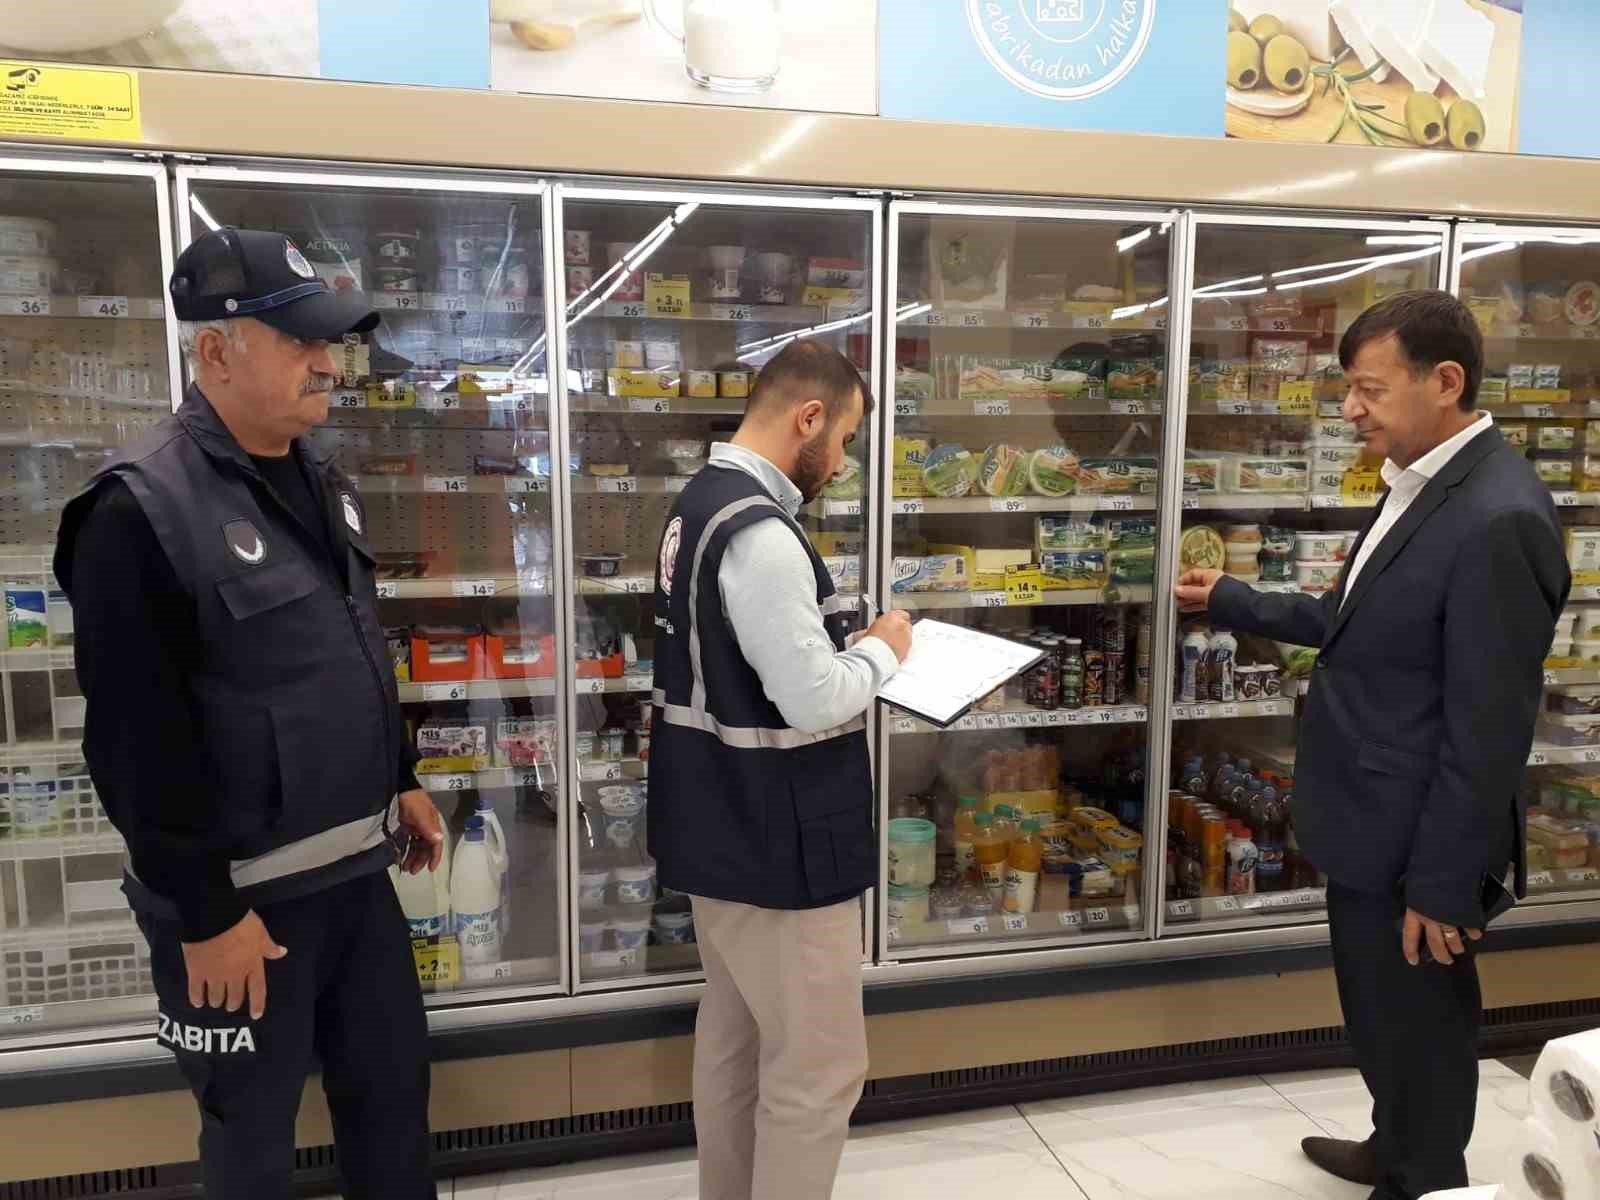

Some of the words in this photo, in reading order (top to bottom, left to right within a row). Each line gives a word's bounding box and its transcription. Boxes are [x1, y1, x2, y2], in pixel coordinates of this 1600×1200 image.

[22, 300, 40, 314] 36
[99, 303, 119, 316] 46
[623, 305, 639, 316] 26
[729, 309, 744, 319] 26
[341, 395, 358, 407] 28
[444, 480, 459, 492] 14
[524, 480, 538, 492] 14
[617, 480, 629, 492] 13
[472, 584, 487, 596] 14
[625, 582, 639, 594] 14
[1018, 582, 1029, 592] 14
[1100, 712, 1110, 721] 19
[448, 778, 464, 789] 23
[158, 1011, 256, 1053] ZABITA
